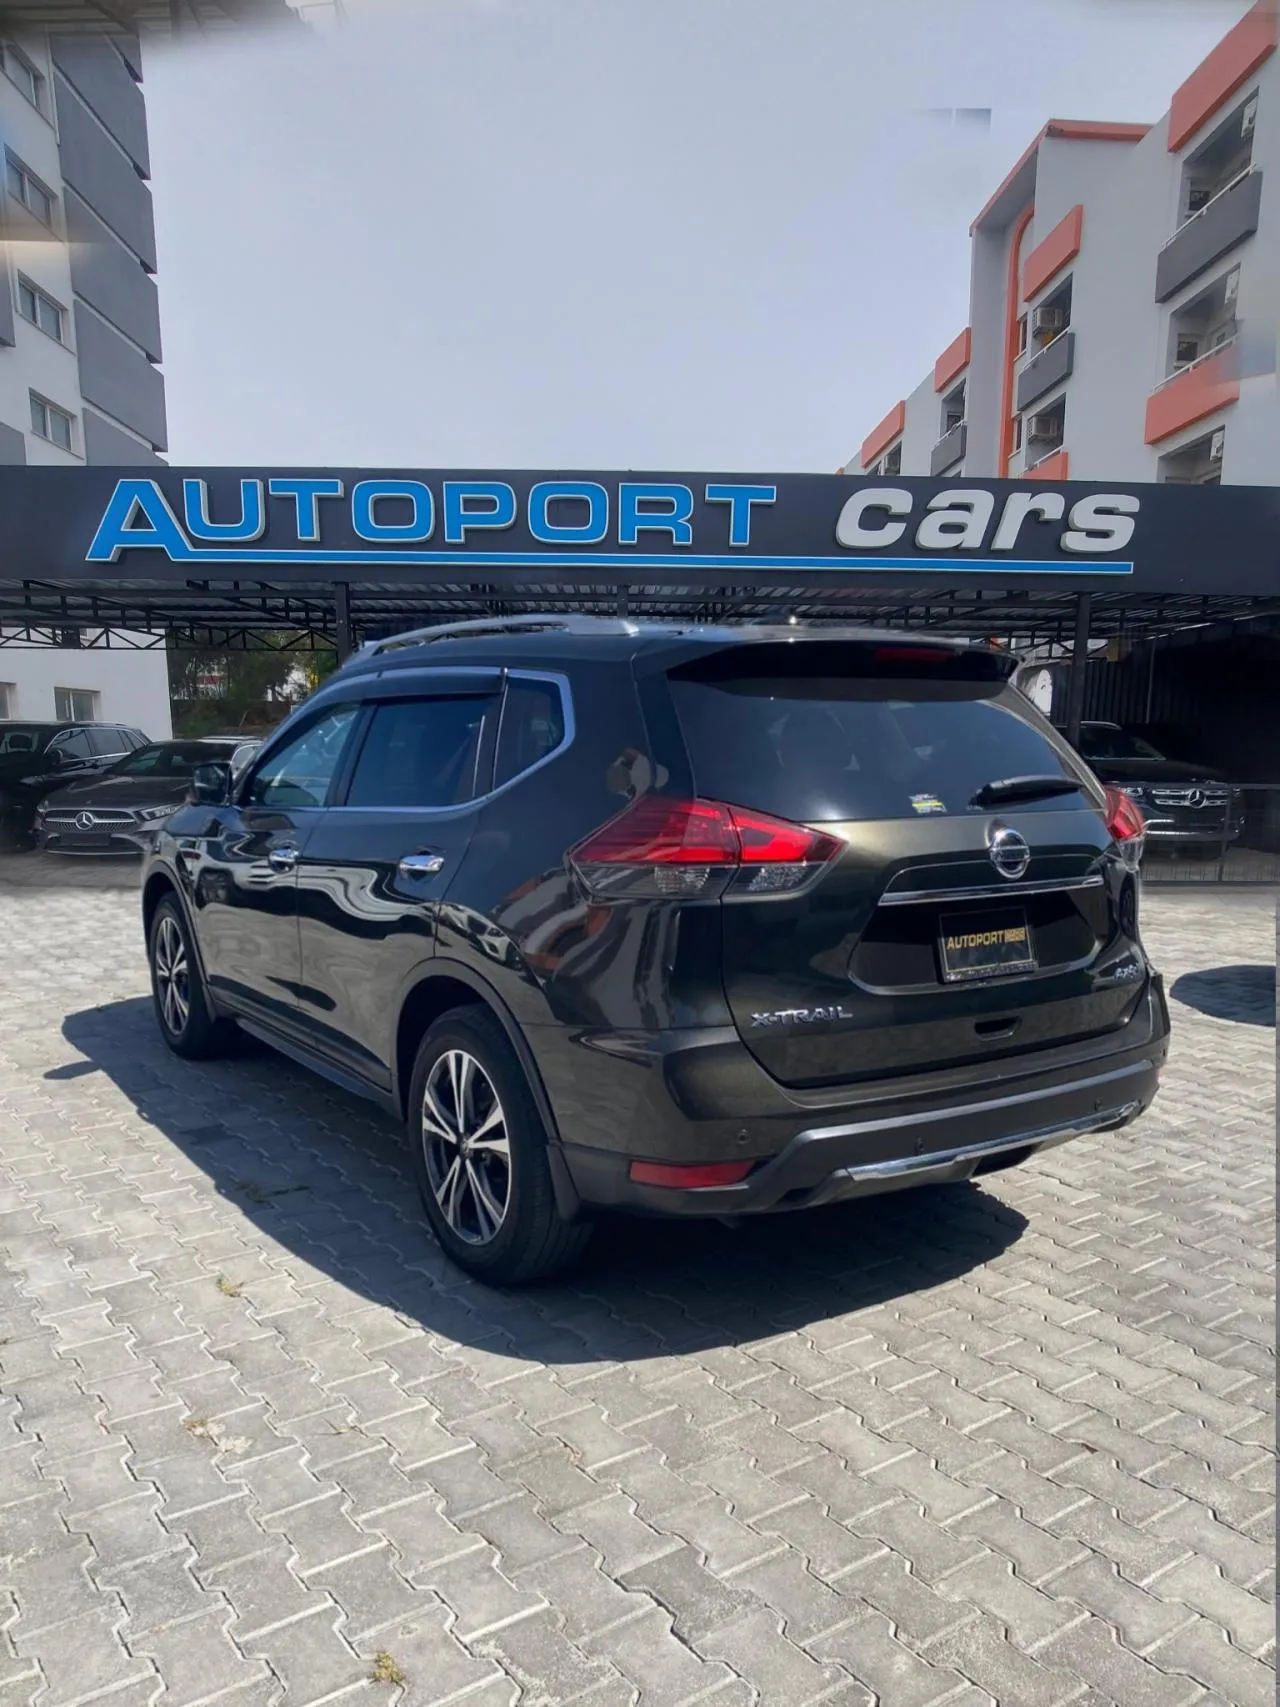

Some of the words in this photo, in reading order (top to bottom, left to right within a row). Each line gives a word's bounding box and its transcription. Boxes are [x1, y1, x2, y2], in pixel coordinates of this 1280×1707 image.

[85, 477, 778, 563] AUTOPORT
[835, 486, 1141, 554] cars
[946, 929, 1004, 949] AUTOPORT
[750, 1006, 854, 1027] X-TRAIL
